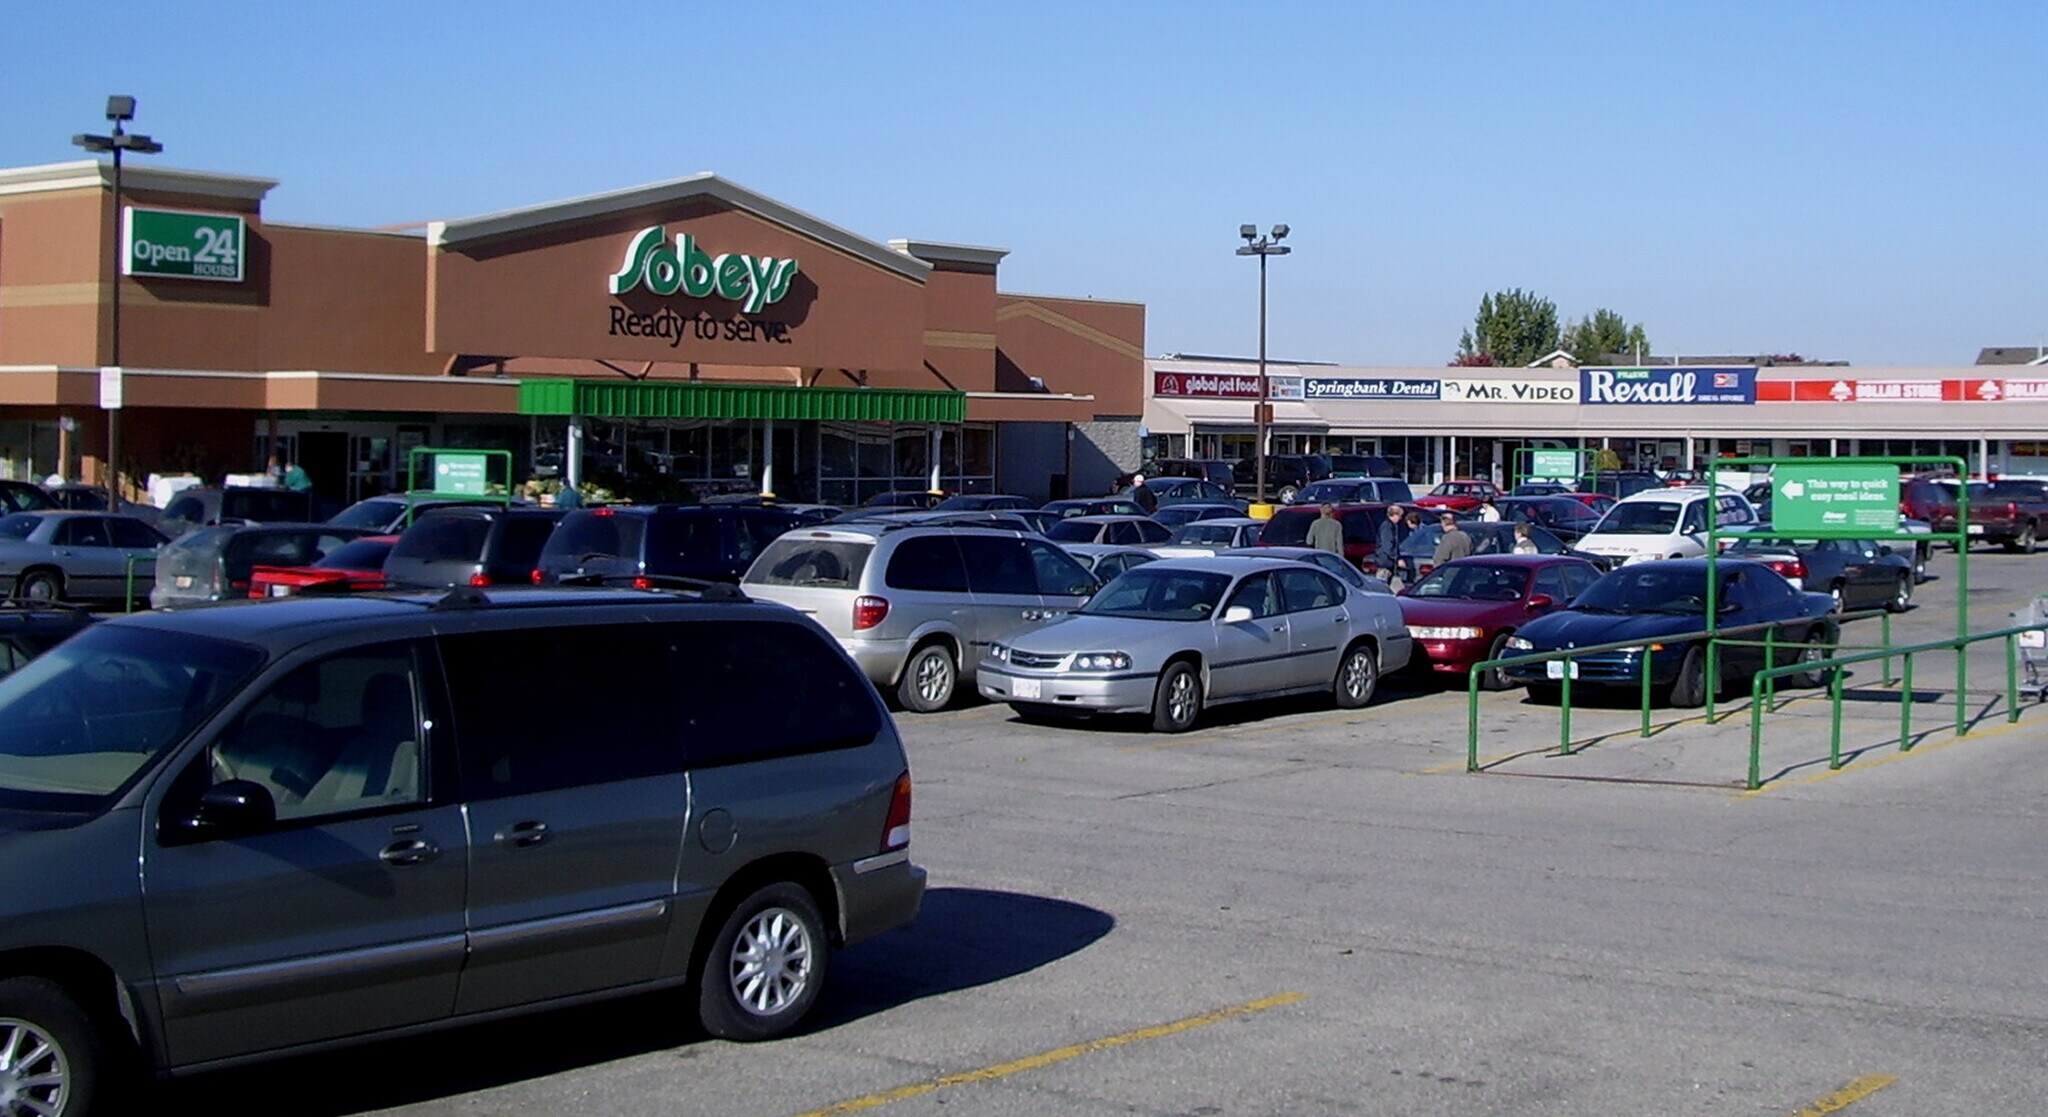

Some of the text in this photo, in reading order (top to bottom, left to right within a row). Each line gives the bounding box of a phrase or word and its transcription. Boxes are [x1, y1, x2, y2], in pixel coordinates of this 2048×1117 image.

[134, 226, 237, 267] Open 24
[193, 263, 236, 277] HOURS
[609, 225, 798, 313] Sobeys
[609, 305, 793, 348] Ready to serve.
[1185, 375, 1218, 395] global
[1306, 381, 1388, 397] Springbank
[1391, 381, 1439, 396] Dental
[1465, 382, 1575, 400] MR. VIDEO
[1588, 371, 1697, 403] Rexall
[1856, 384, 1941, 398] DOLLAR STORE
[1807, 479, 1828, 489] This
[1829, 480, 1850, 491] way
[1850, 479, 1861, 489] to
